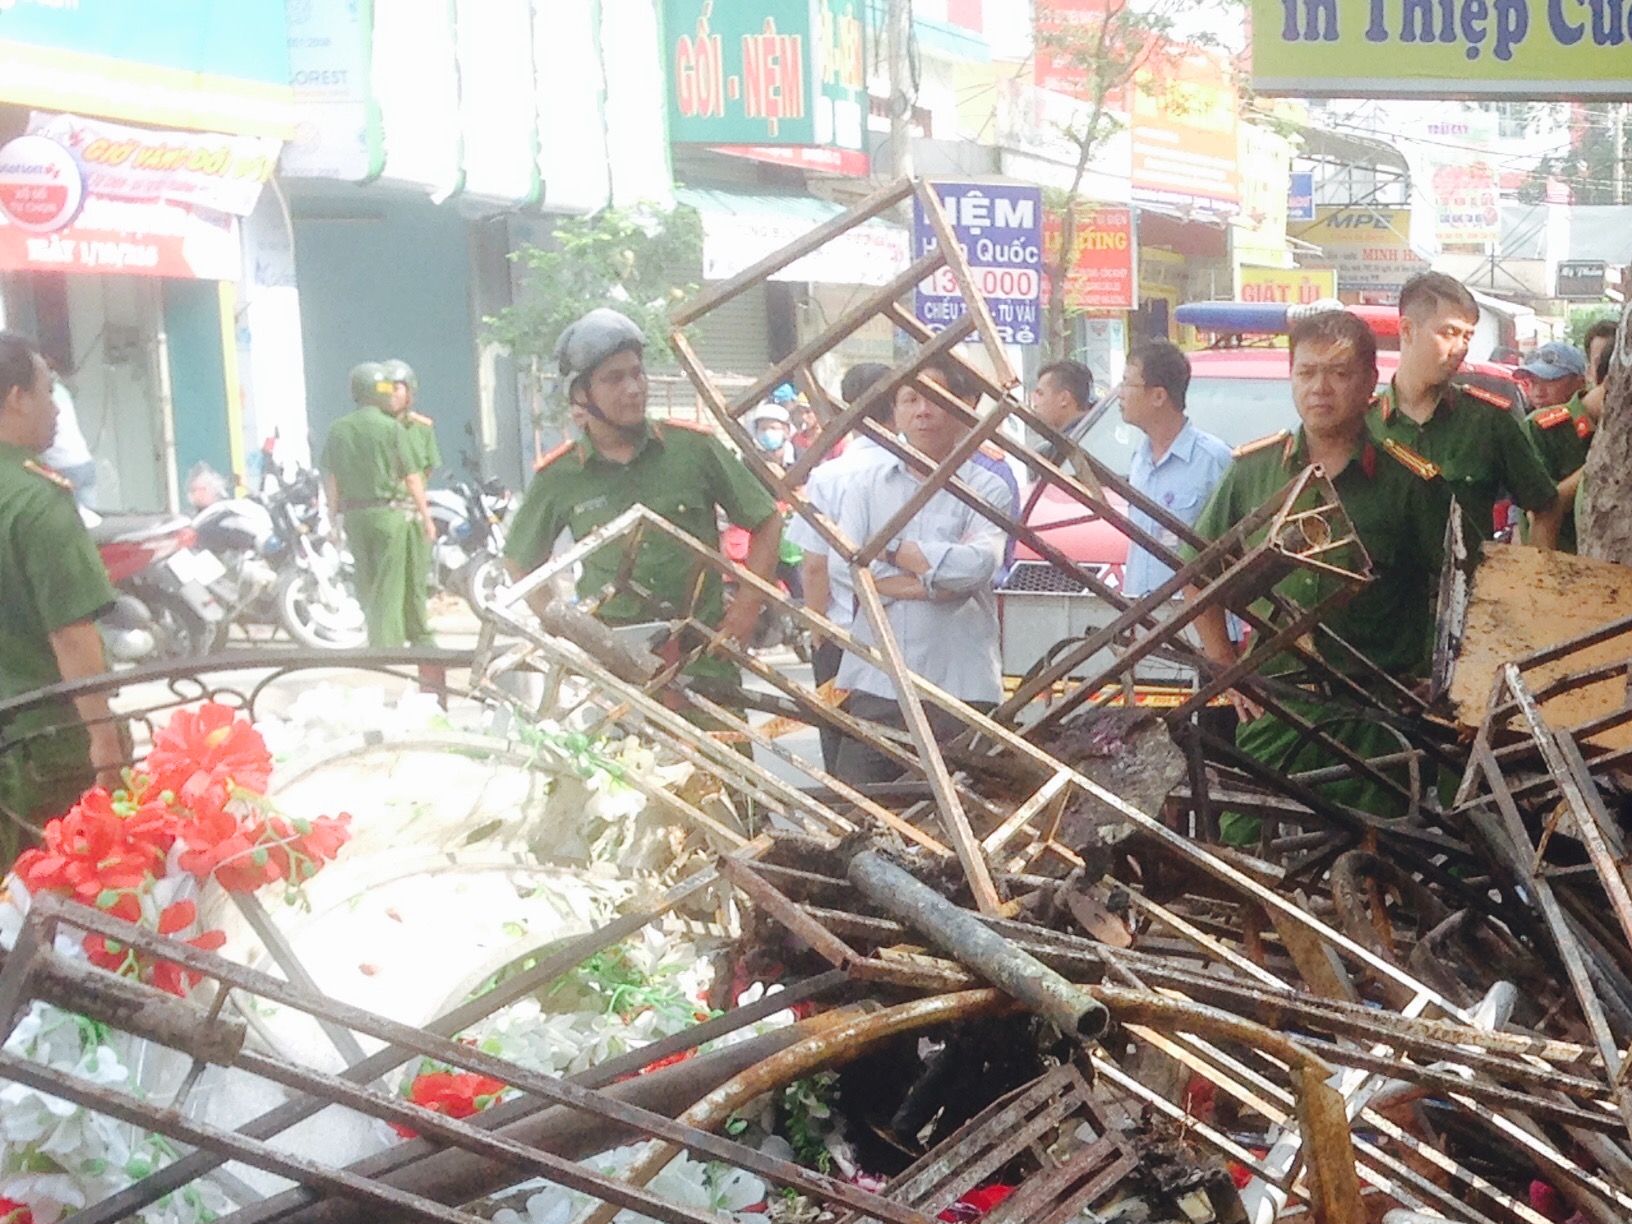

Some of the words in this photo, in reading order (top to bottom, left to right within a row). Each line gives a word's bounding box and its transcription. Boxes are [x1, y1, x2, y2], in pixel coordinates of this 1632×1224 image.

[289, 70, 349, 86] OREST
[677, 0, 724, 117] GỐI
[742, 16, 804, 136] NỆM
[1326, 213, 1394, 231] MPE
[976, 237, 1039, 264] Quốc
[1362, 248, 1397, 262] MINH
[924, 296, 958, 320] CHIẾU
